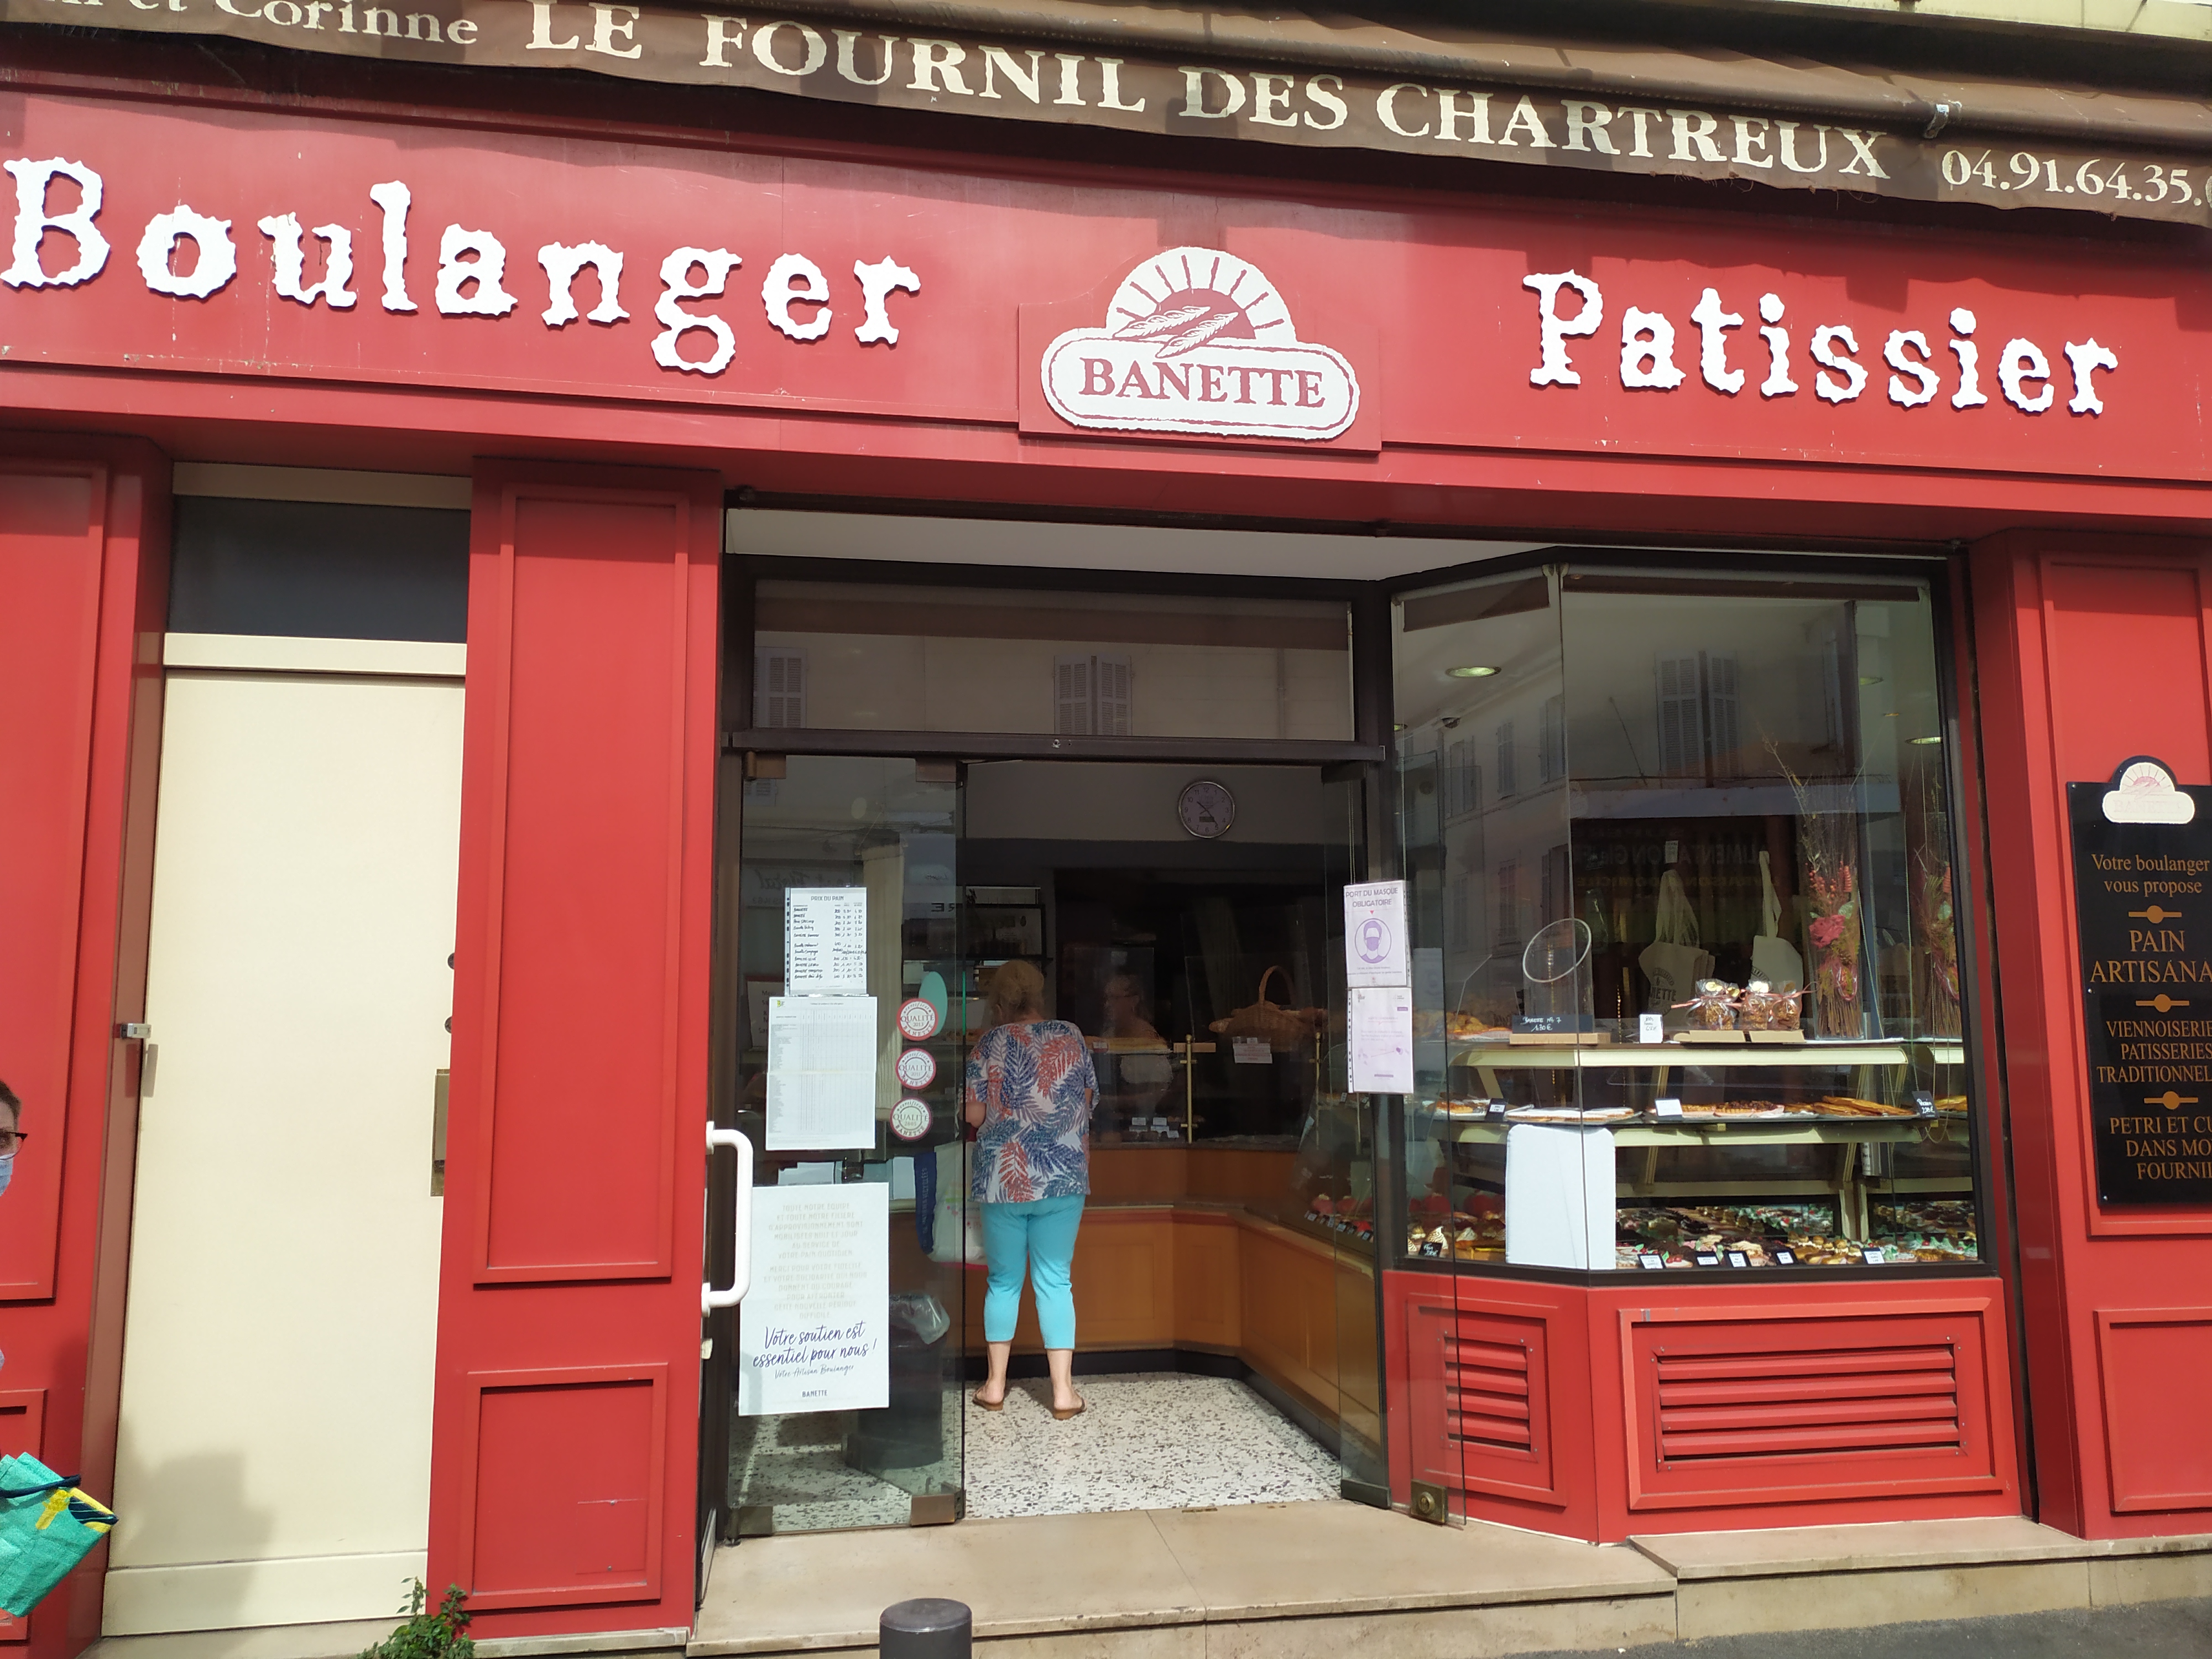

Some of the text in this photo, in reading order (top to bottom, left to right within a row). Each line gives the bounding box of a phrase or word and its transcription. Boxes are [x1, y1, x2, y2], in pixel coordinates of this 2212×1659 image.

[526, 1, 642, 59] LE
[699, 16, 1146, 112] FOURNIL
[1178, 66, 1348, 130] DES
[1376, 82, 1891, 179] CHARTREUX
[0, 156, 921, 374] Boulanger
[1522, 269, 2119, 415] Patissier
[1079, 357, 1326, 408] BANETTE
[2091, 854, 2210, 875] Votre boulanger
[2104, 880, 2202, 897] vous propose
[1352, 899, 1392, 907] OBLIGATOIRE
[2129, 930, 2185, 952] PAIN
[2089, 961, 2212, 983] ARTISANA
[905, 1001, 930, 1011] certificat
[900, 1013, 934, 1022] QUALITÉ
[902, 1024, 933, 1037] BANETTE
[2106, 1020, 2212, 1038] VIENNOISERIE
[904, 1051, 928, 1061] certificat
[2121, 1043, 2212, 1060] PATISSERIES
[898, 1063, 932, 1072] QUALITÉ
[2096, 1066, 2212, 1083] TRADITIONNEL
[893, 1113, 928, 1121] QUALITÉ
[2109, 1117, 2162, 1135] PETRI
[2166, 1116, 2189, 1134] ET
[895, 1125, 925, 1137] BANETTE
[2125, 1139, 2177, 1157] DANS
[818, 1250, 852, 1258] QUOTIDIEN
[822, 1281, 852, 1290] COURAGE
[764, 1320, 867, 1350] Votre soutien est
[753, 1345, 811, 1368] essentiel
[809, 1348, 838, 1367] pour
[839, 1344, 870, 1358] nous
[775, 1363, 854, 1380] Votre Artisan Boulanger
[802, 1389, 828, 1398] BANETTE
